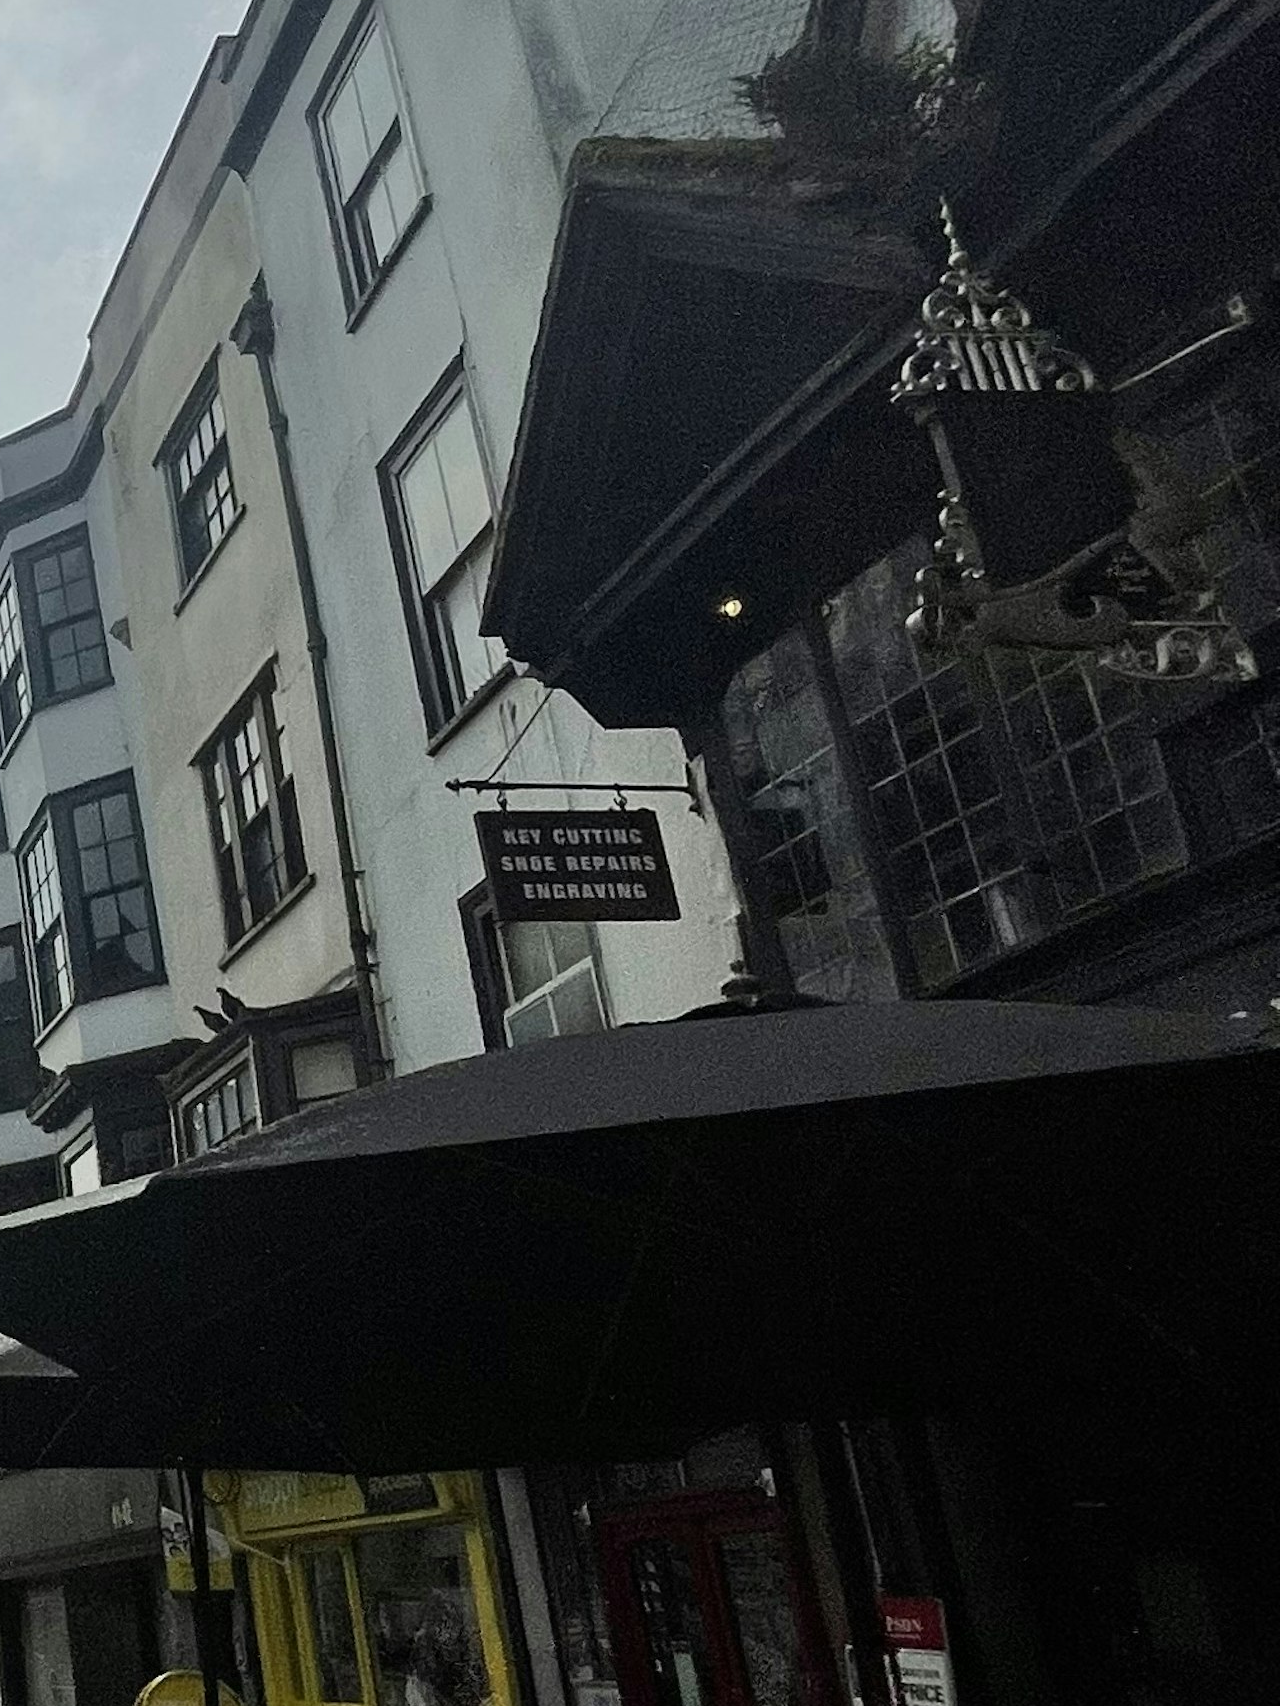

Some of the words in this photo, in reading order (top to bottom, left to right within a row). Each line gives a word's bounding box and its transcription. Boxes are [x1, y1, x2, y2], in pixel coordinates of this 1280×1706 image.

[502, 828, 541, 846] KEY
[552, 827, 643, 846] CUTTING
[500, 855, 558, 873] SHOE
[565, 855, 657, 873] REPAIRS
[523, 882, 648, 900] ENGRAVING
